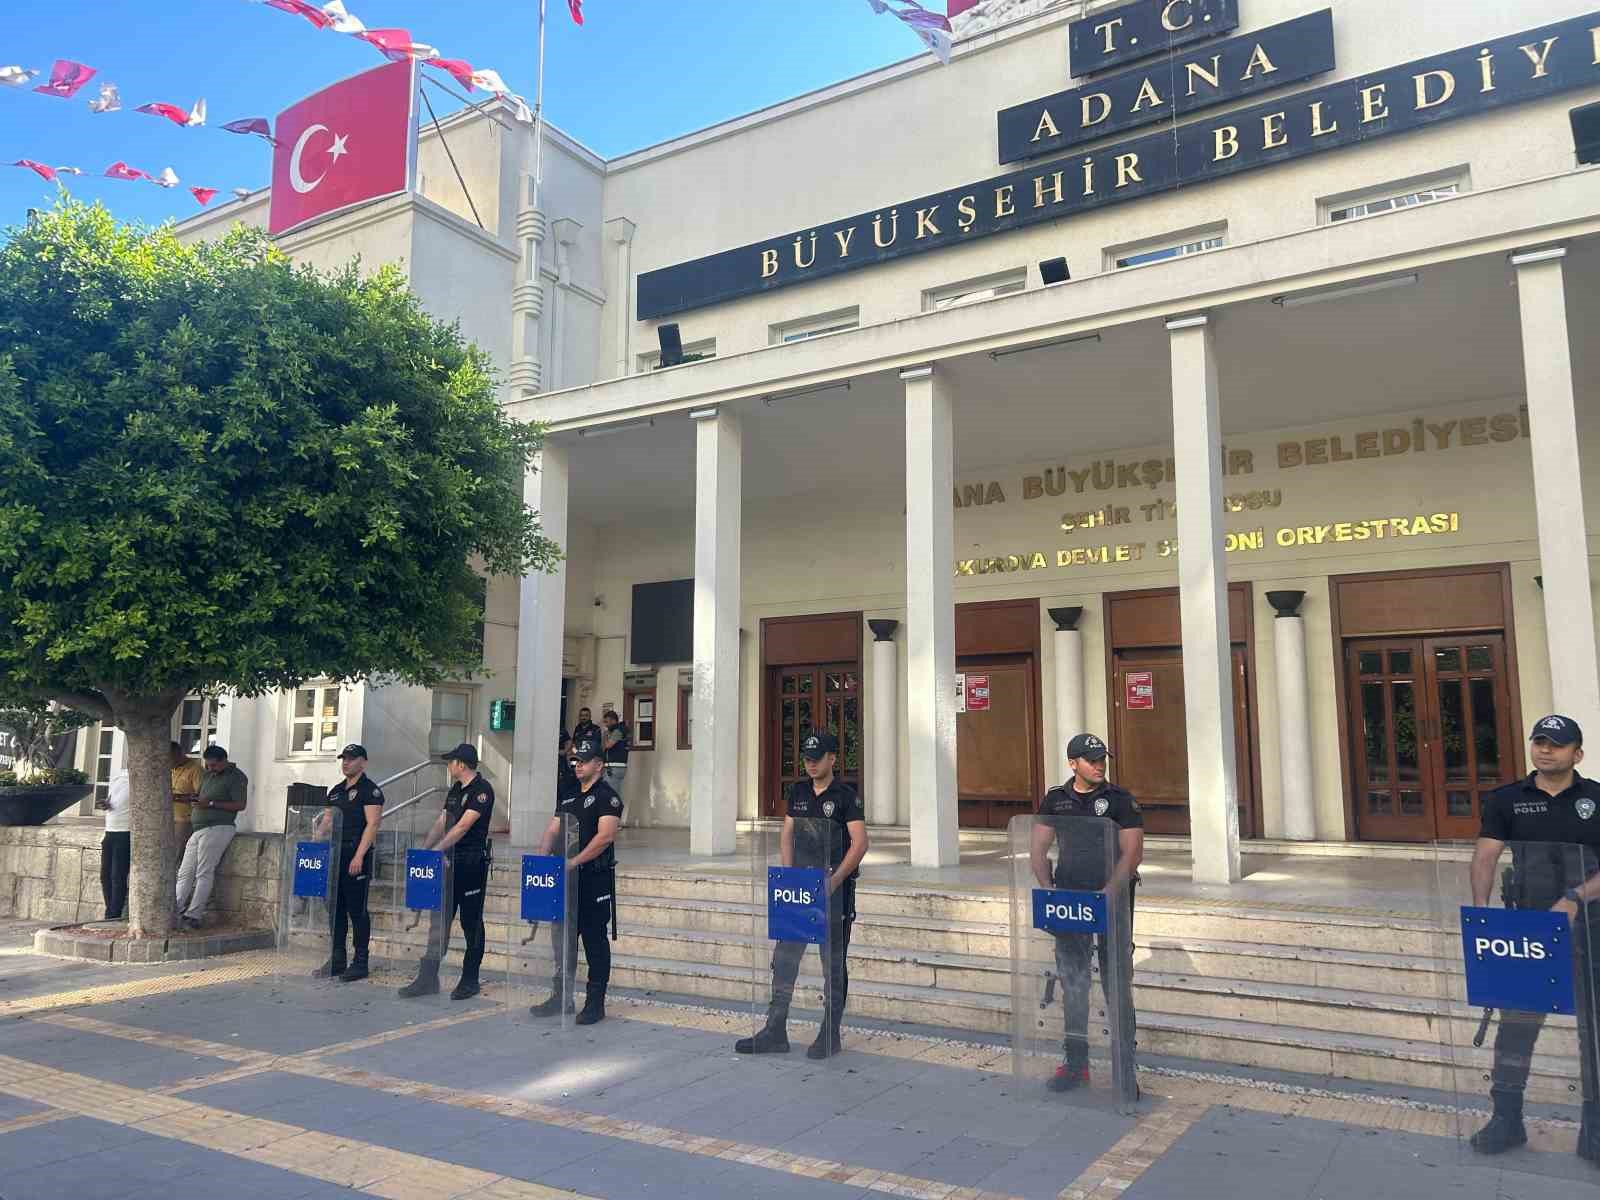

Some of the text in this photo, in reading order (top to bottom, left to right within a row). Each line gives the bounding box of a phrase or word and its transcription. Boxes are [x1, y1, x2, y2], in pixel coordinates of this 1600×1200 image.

[1094, 0, 1211, 53] T. C.
[1030, 43, 1277, 142] ADANA
[761, 152, 1143, 278] BÜYÜKŞEHİR
[1277, 404, 1530, 468] BELEDİYESİ
[1060, 503, 1131, 534] ŞEHİR
[1055, 543, 1146, 567] DEVLET
[1276, 512, 1459, 547] ORKESTRASI
[299, 858, 322, 870] POLİS
[409, 865, 434, 879] POLİS
[526, 873, 555, 888] POLİS
[774, 887, 811, 905] POLİS
[1045, 903, 1093, 922] POLİS
[1475, 937, 1546, 960] POLİS
